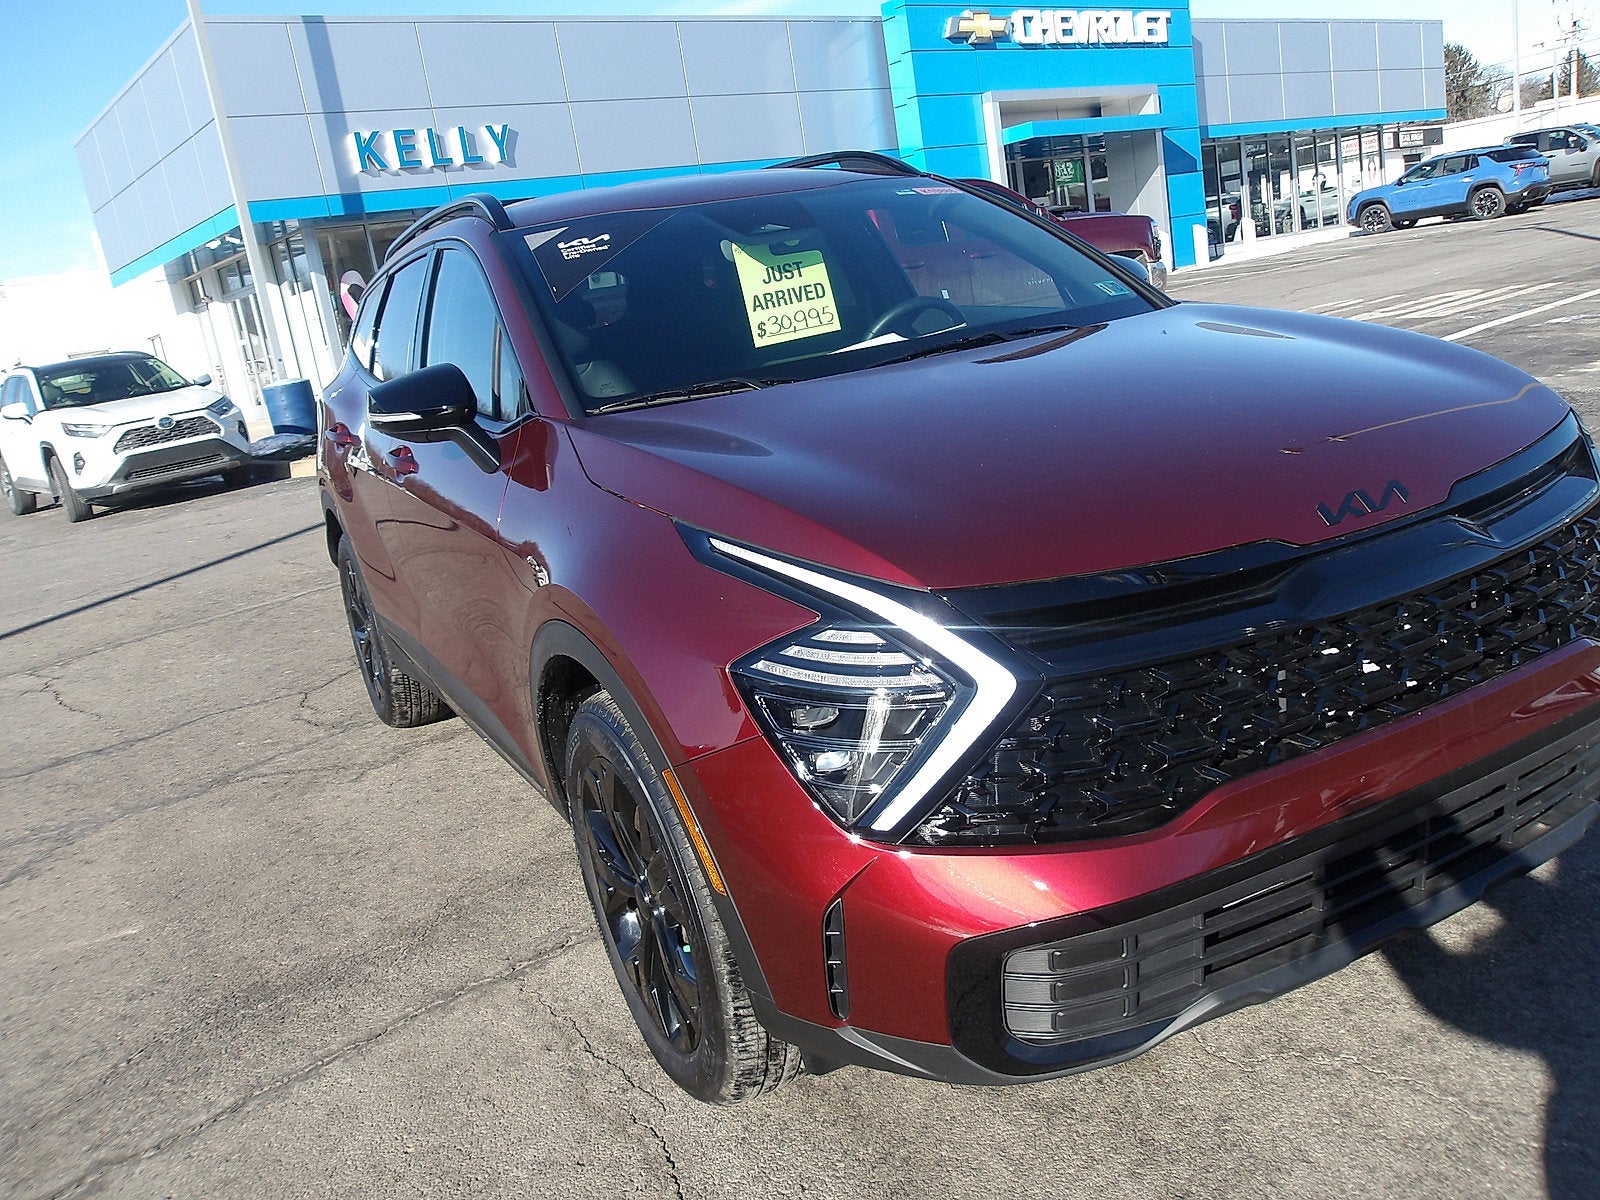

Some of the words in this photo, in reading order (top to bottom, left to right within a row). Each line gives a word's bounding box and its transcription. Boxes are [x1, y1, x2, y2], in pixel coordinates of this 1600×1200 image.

[1011, 9, 1170, 45] CHEVROLET
[353, 124, 509, 171] KELLY
[762, 261, 803, 284] JUST
[752, 282, 826, 312] ARRIVED
[1316, 479, 1410, 527] KIA
